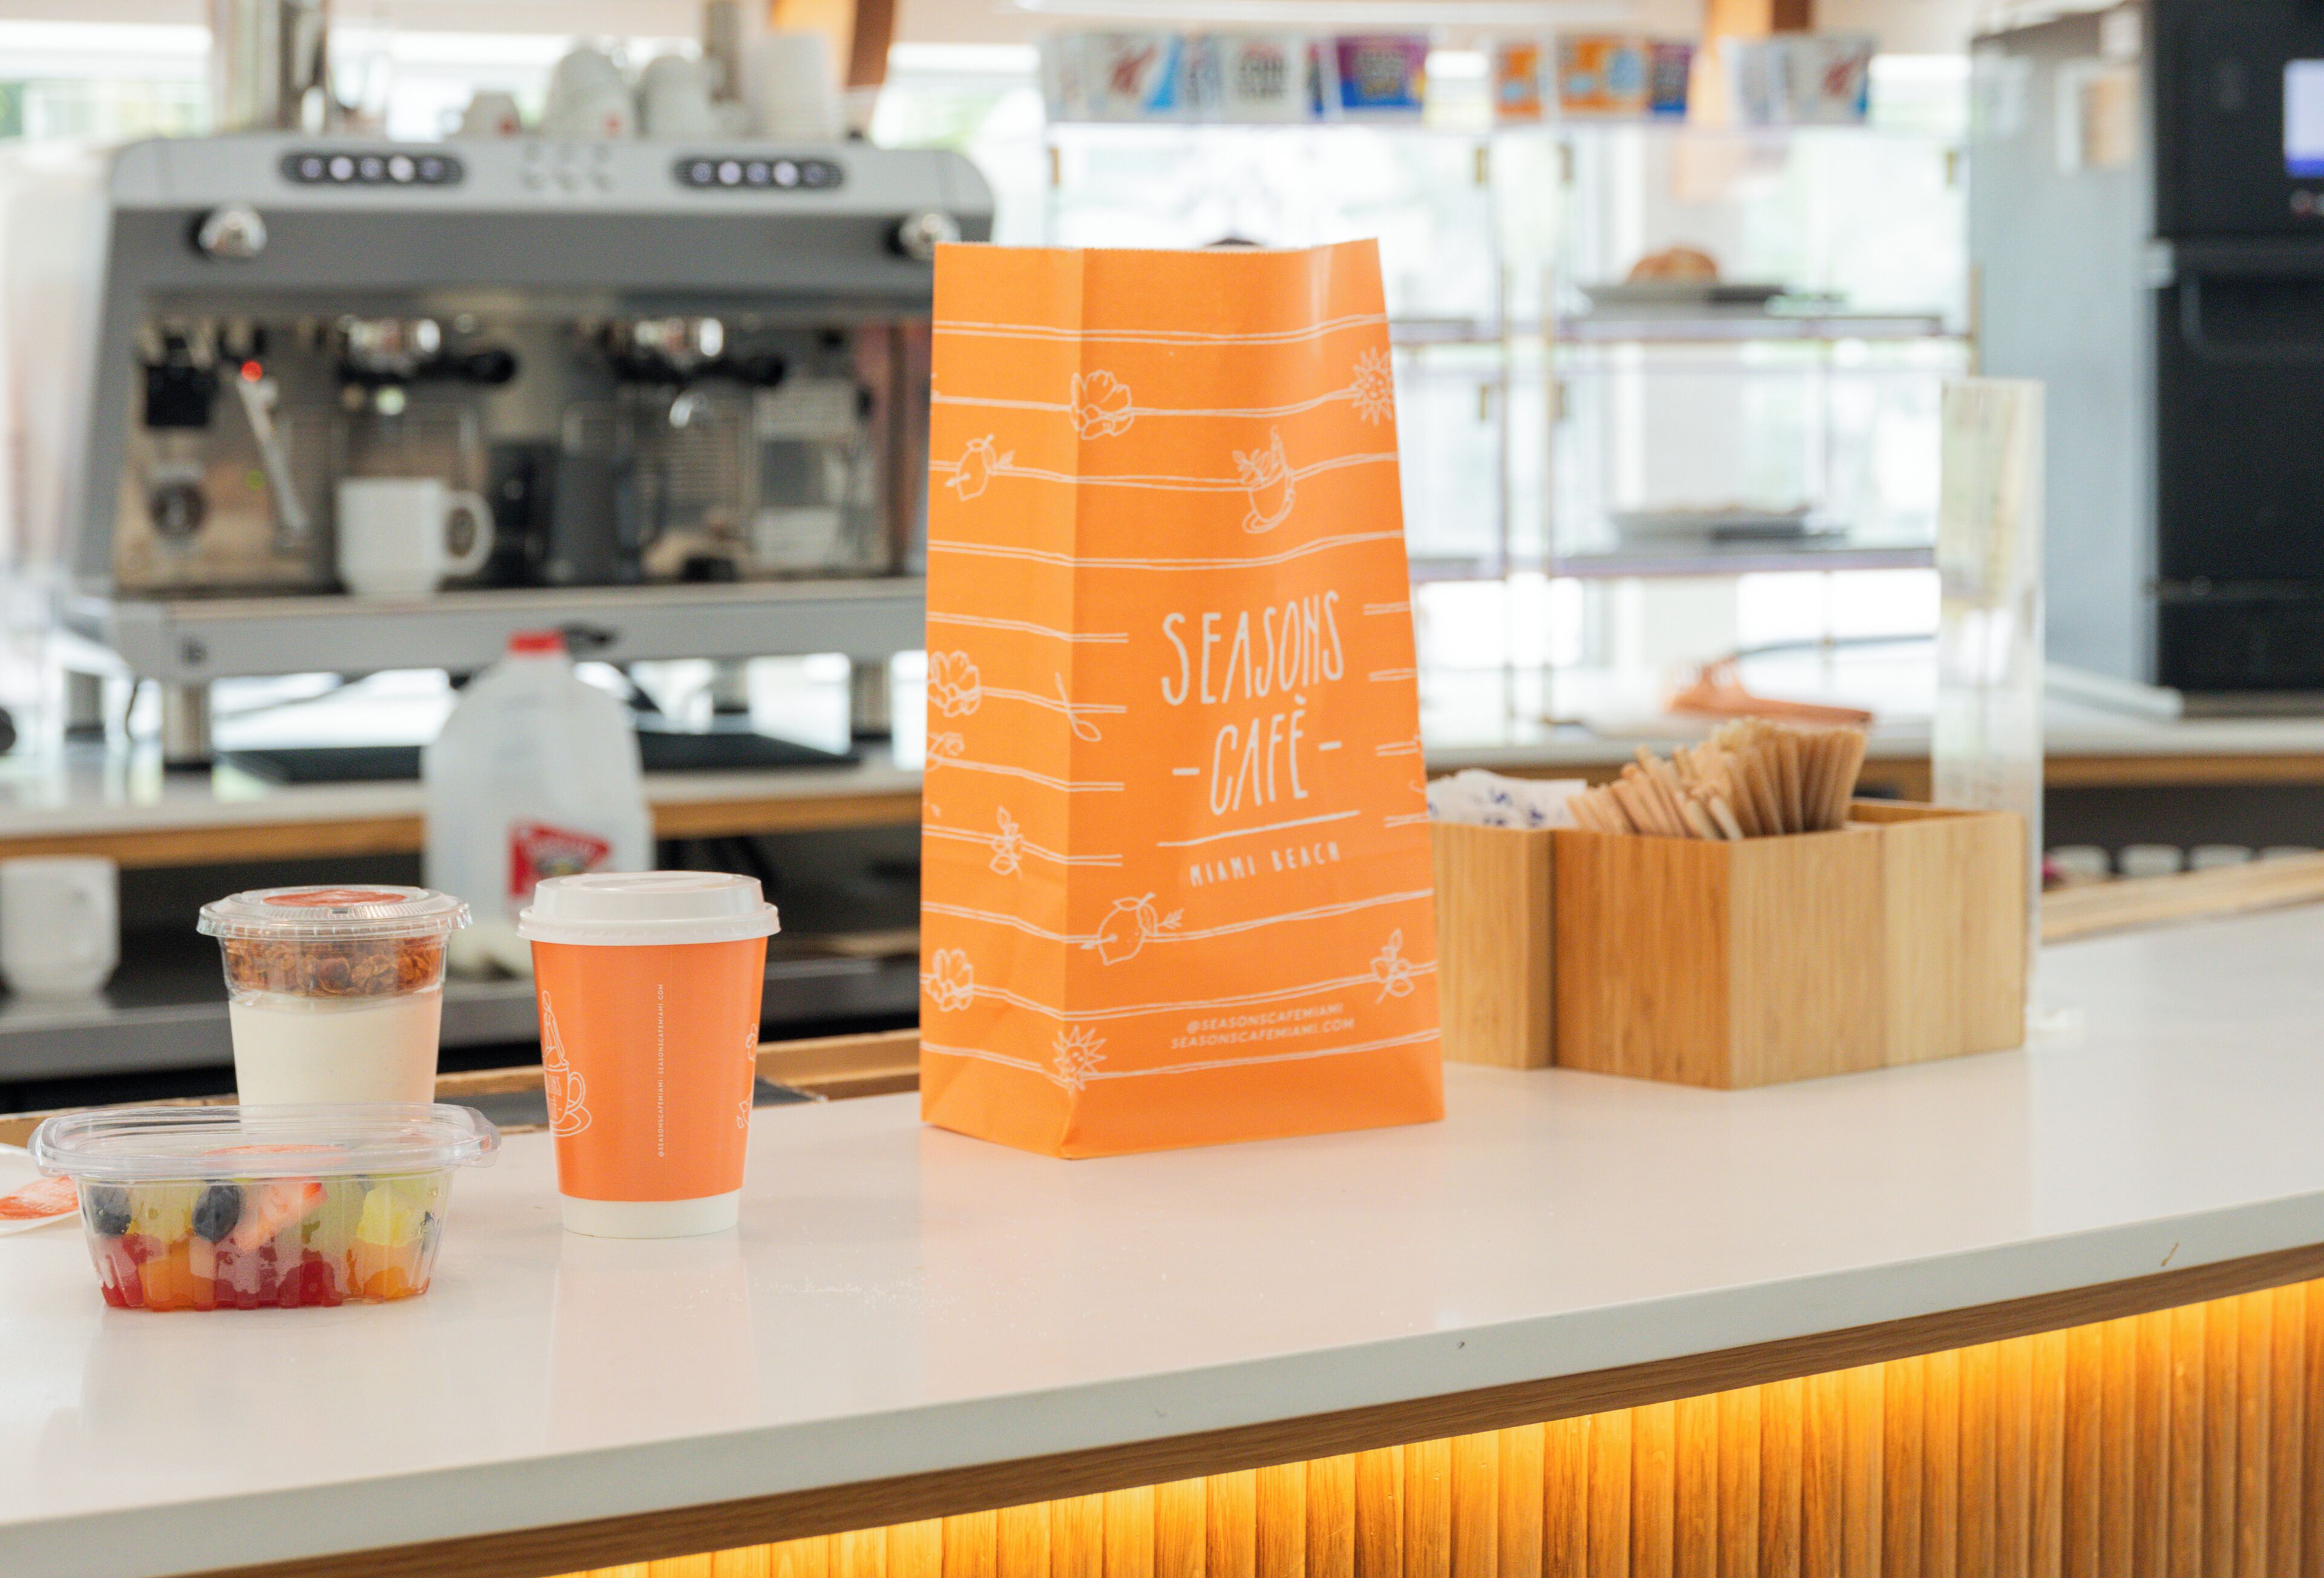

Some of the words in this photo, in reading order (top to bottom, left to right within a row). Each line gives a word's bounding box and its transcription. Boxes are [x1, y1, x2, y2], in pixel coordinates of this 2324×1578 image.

[1161, 590, 1344, 706] SEASONS
[1189, 855, 1256, 887] MIAMI
[1270, 841, 1340, 872] BEACH
[1171, 1017, 1355, 1050] SEASONSCAFEMIAMI.COM
[1186, 1002, 1344, 1034] @SEASONSCAFEMIAMI
